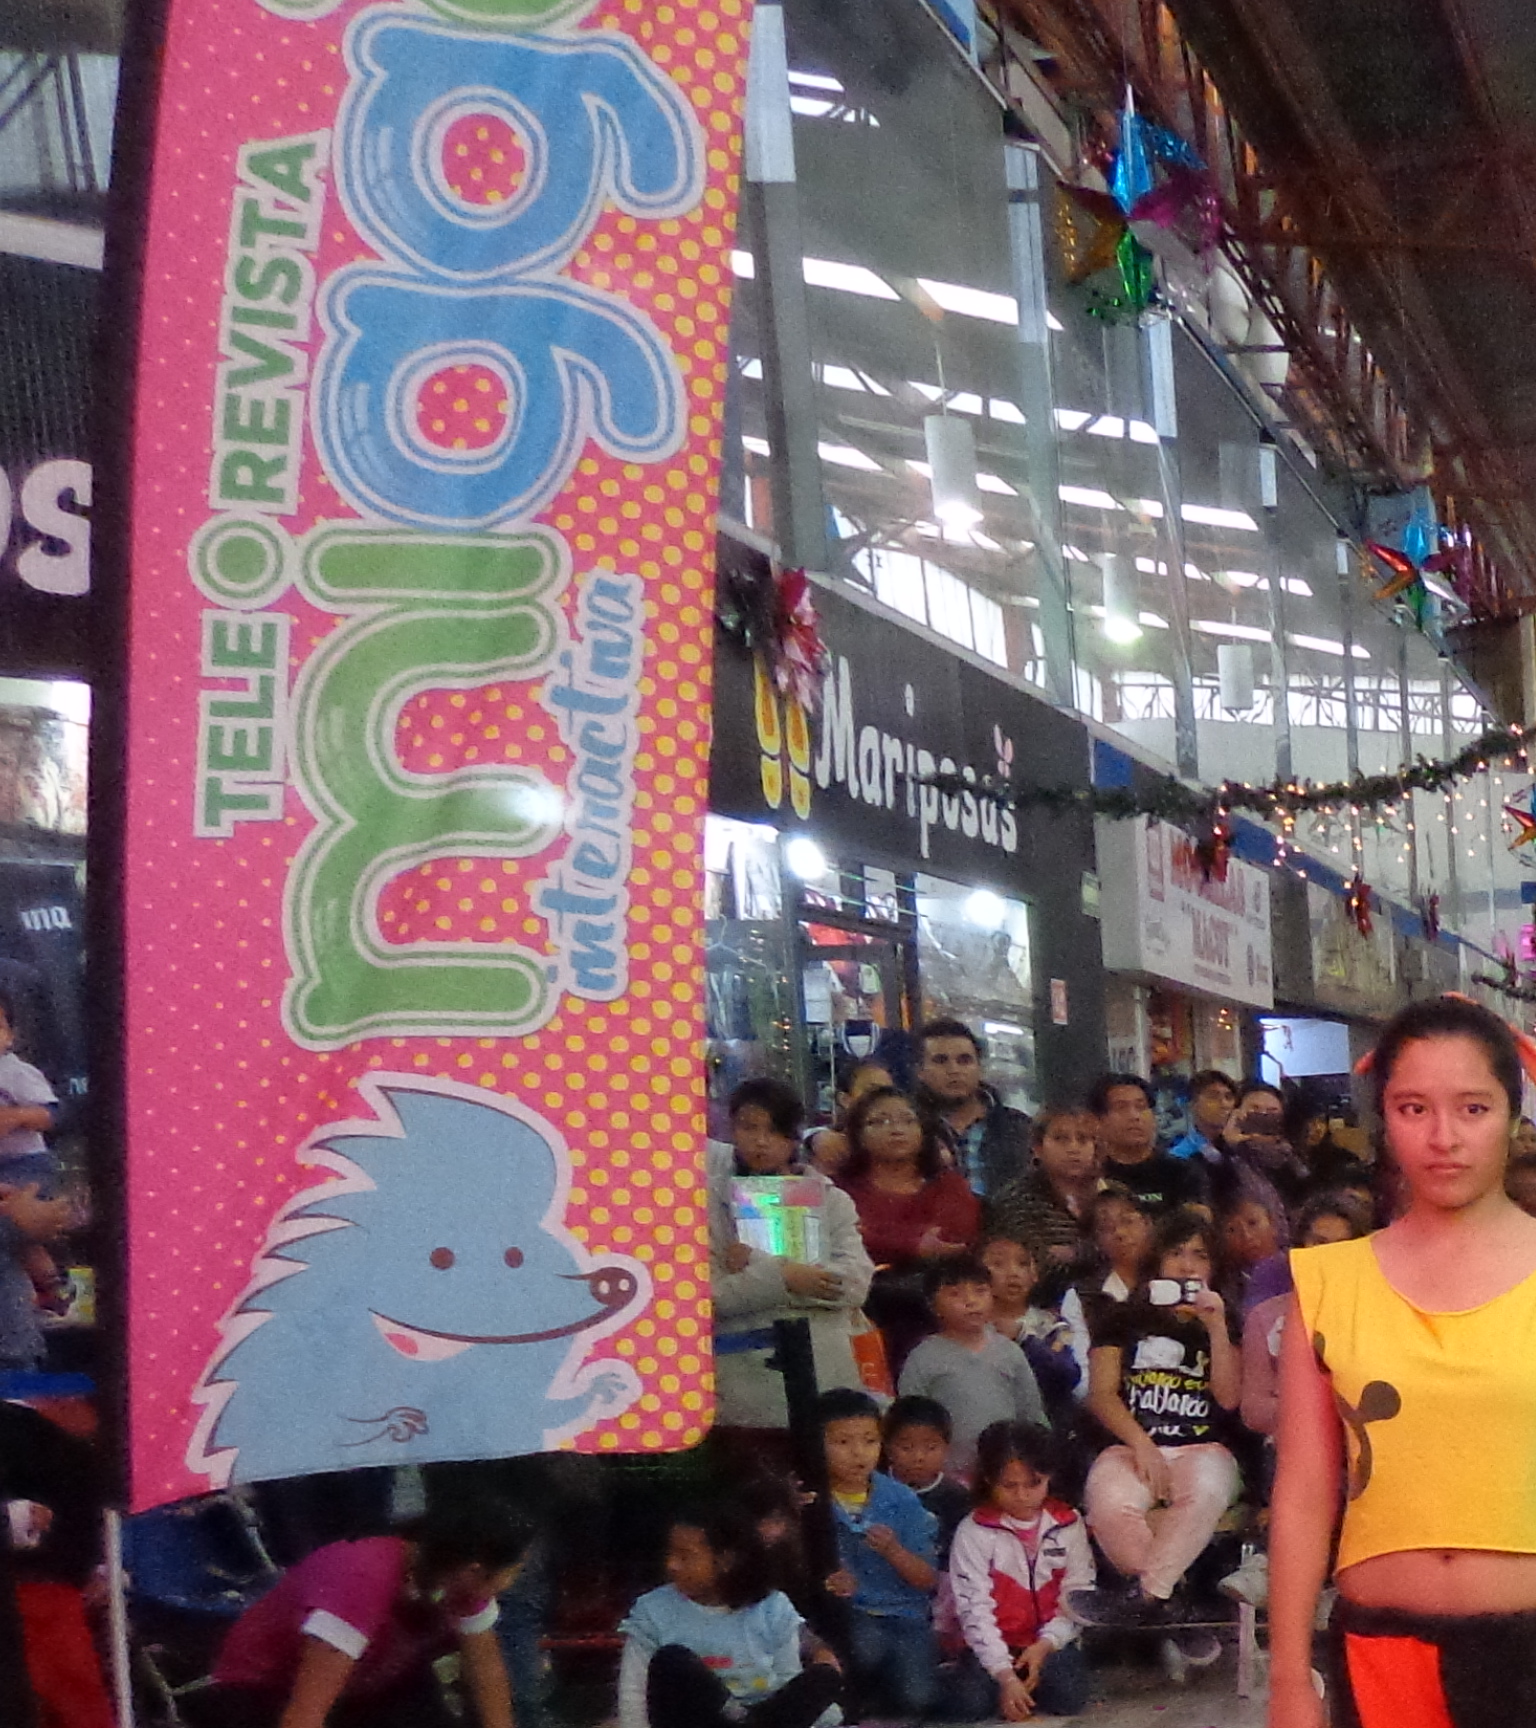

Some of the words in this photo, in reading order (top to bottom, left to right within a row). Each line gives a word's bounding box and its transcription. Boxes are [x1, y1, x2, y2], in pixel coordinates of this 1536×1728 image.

[220, 141, 320, 506] REVISTA
[207, 619, 277, 829] TELE
[541, 575, 634, 994] interactiva
